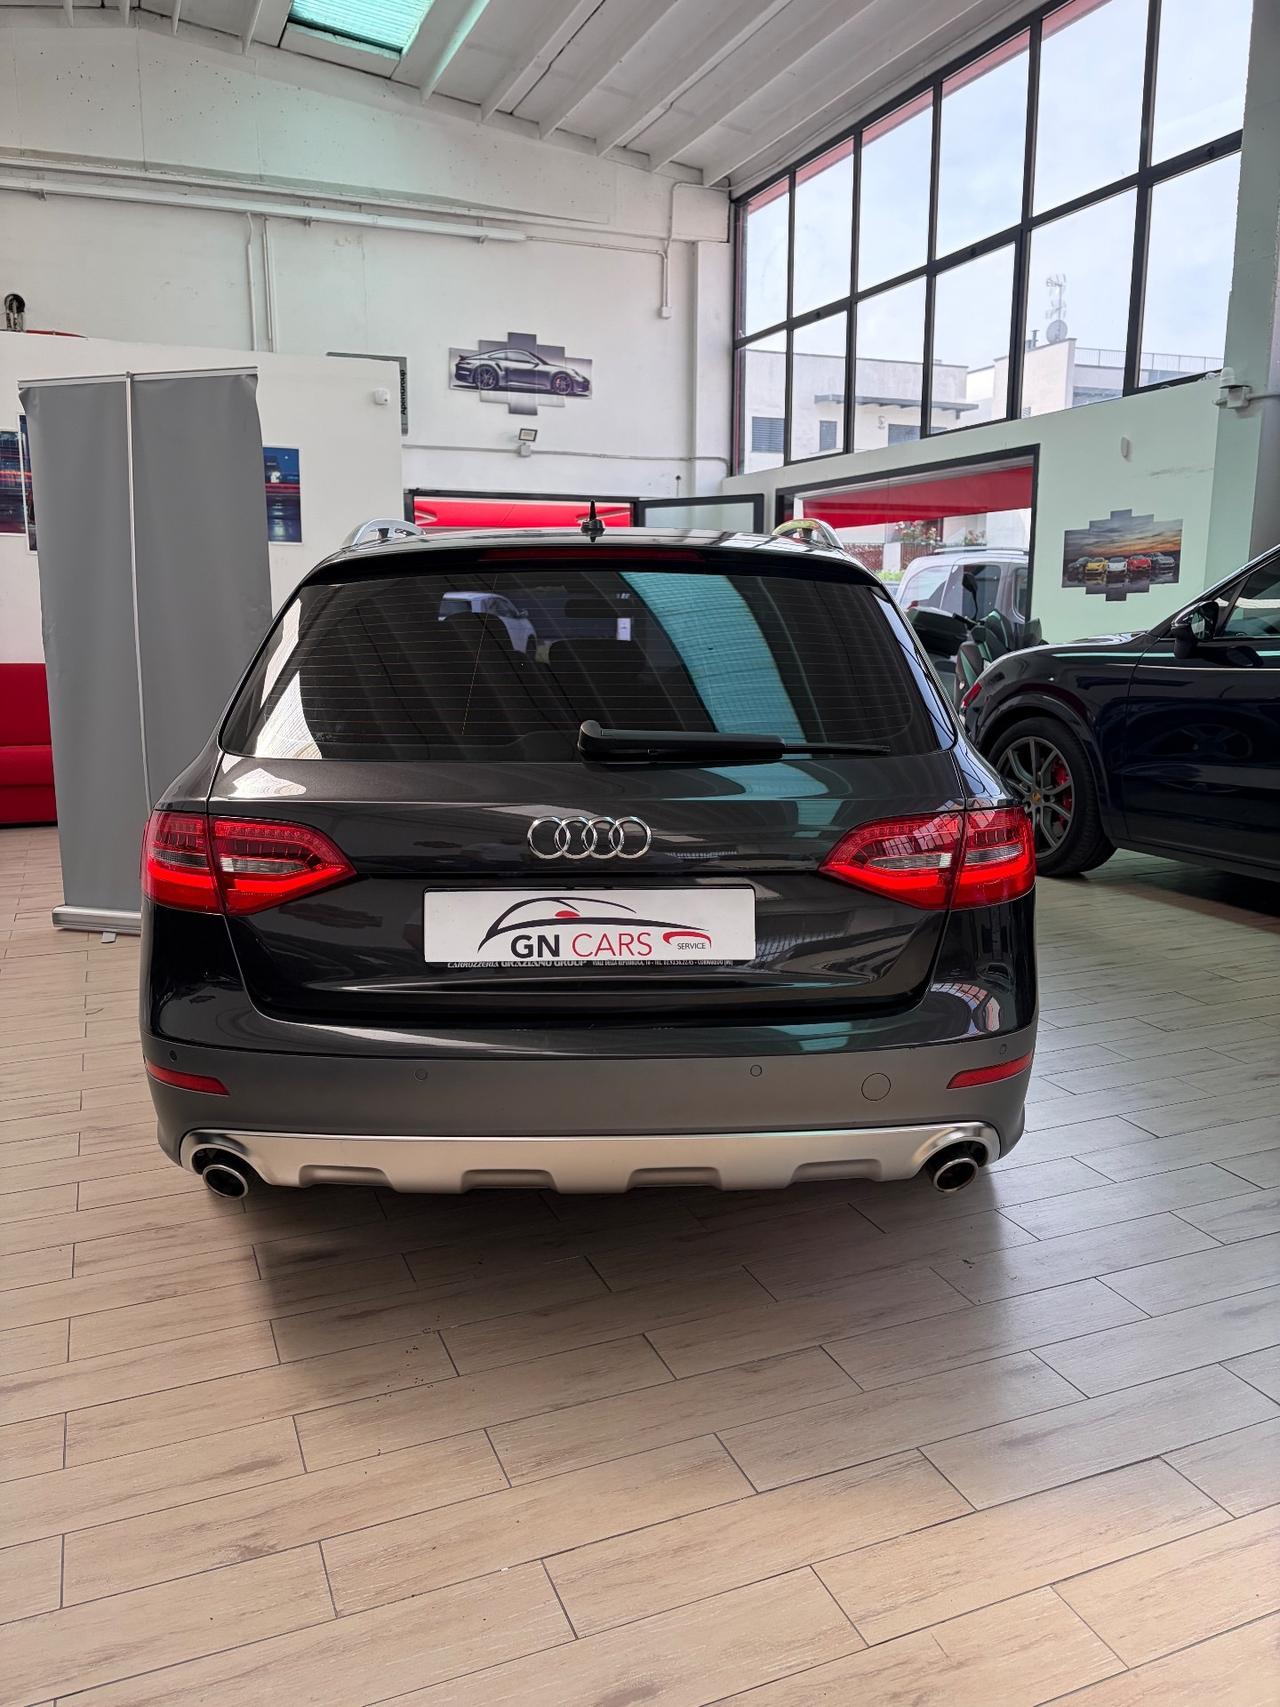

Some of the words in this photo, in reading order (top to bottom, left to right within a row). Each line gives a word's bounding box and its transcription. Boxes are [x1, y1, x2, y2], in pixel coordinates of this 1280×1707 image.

[510, 934, 560, 959] GN
[571, 932, 653, 958] CARS
[677, 942, 706, 950] SERVICE
